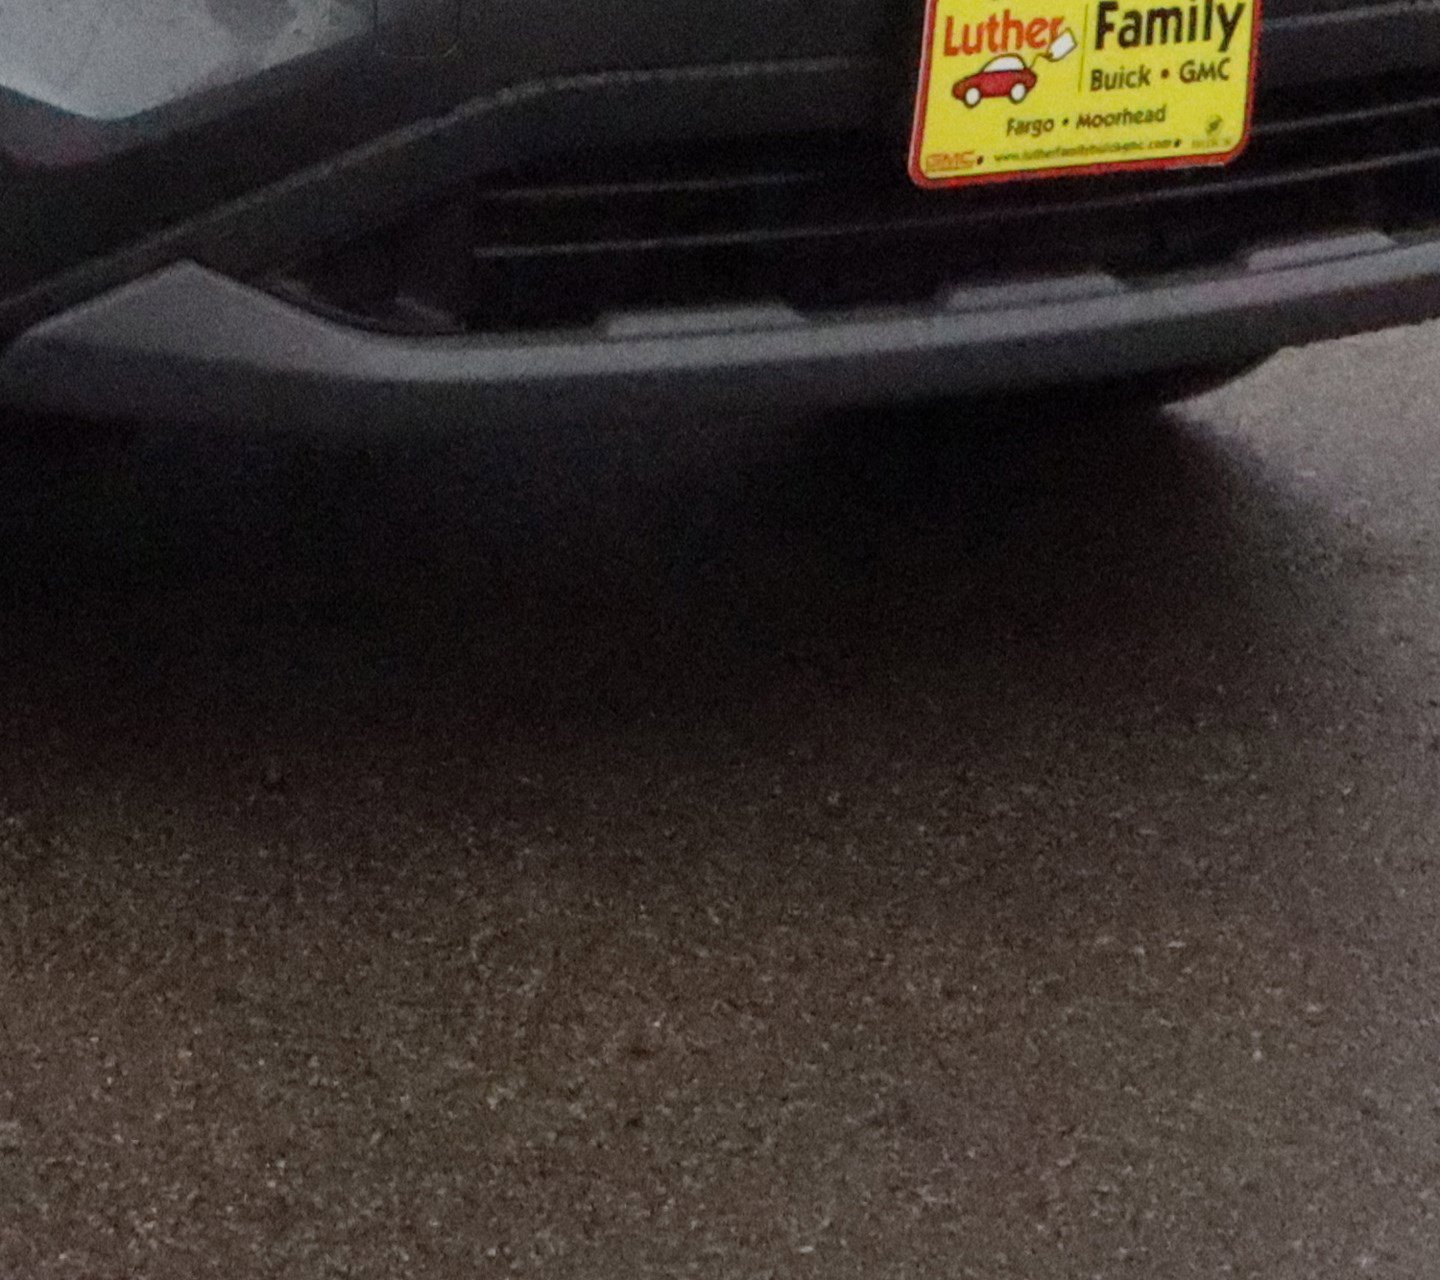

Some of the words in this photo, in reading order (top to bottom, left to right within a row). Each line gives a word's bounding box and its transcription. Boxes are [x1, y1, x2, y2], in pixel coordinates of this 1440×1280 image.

[943, 8, 1064, 56] Luther
[1090, 64, 1151, 91] Buick
[1179, 56, 1231, 83] GMC
[1006, 117, 1055, 138] Fargo
[1076, 103, 1167, 130] Moorhead
